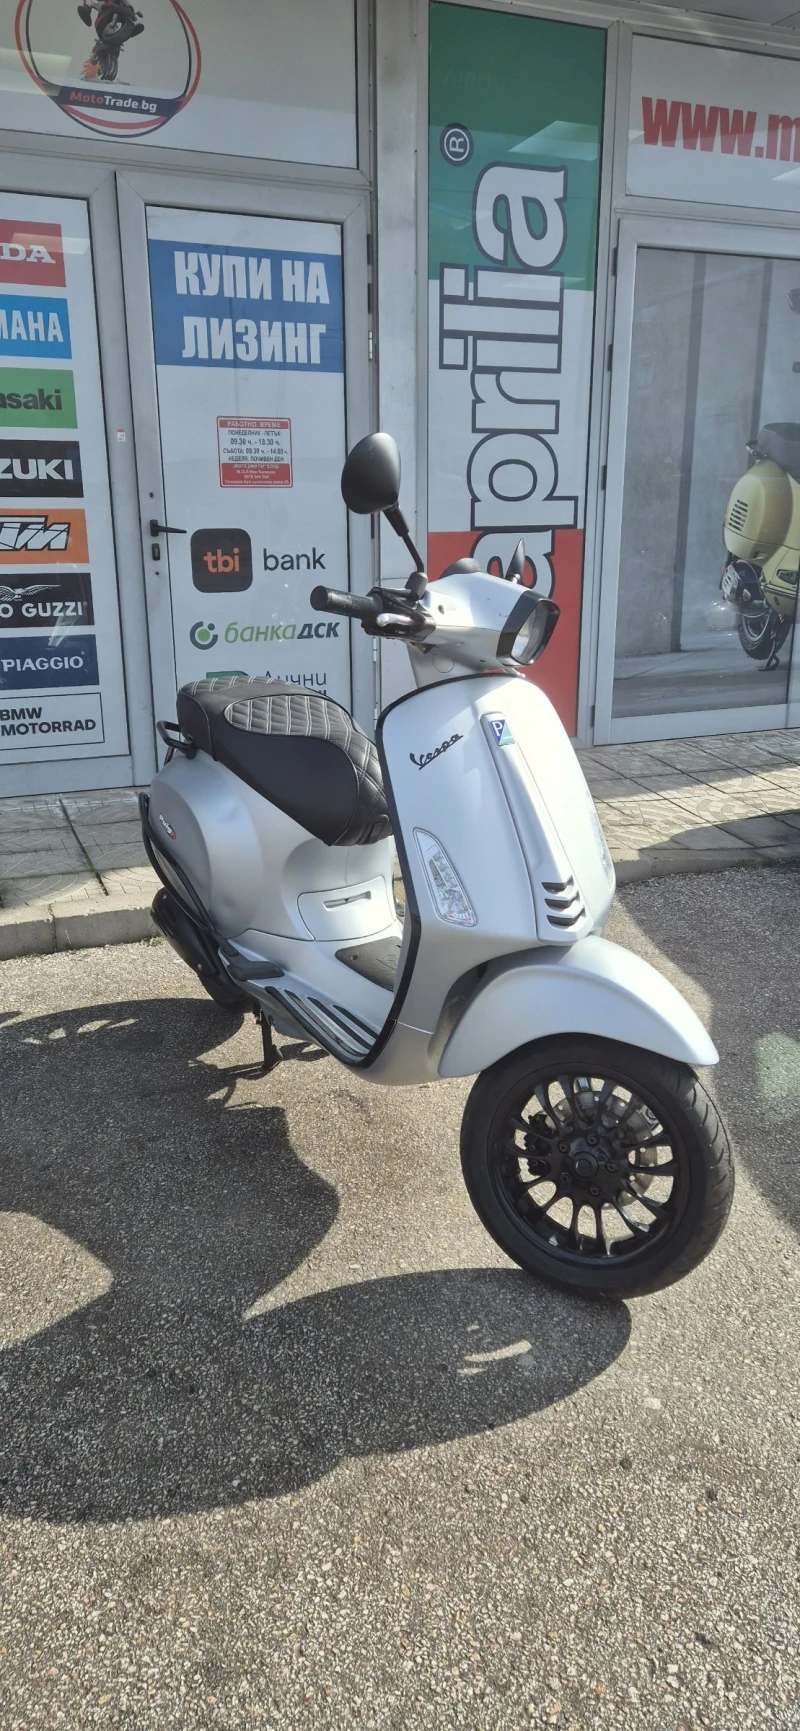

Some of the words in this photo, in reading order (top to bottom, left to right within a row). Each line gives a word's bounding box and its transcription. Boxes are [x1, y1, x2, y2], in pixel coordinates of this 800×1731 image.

[70, 91, 157, 113] MotoTrade.bg
[174, 250, 272, 301] КУПИ
[282, 259, 330, 305] НА
[182, 316, 327, 364] ЛИЗИНГ
[438, 160, 580, 598] aprilia
[226, 420, 257, 428] РАБОТНО
[260, 421, 282, 429] ВРЕМЕ
[203, 547, 240, 573] tbi
[263, 547, 326, 571] bank
[21, 601, 83, 618] GUZZI
[1, 655, 84, 672] PIAGGIO
[0, 707, 42, 721] BMW
[1, 719, 96, 736] MOTORRAD
[409, 733, 464, 771] Vespa
